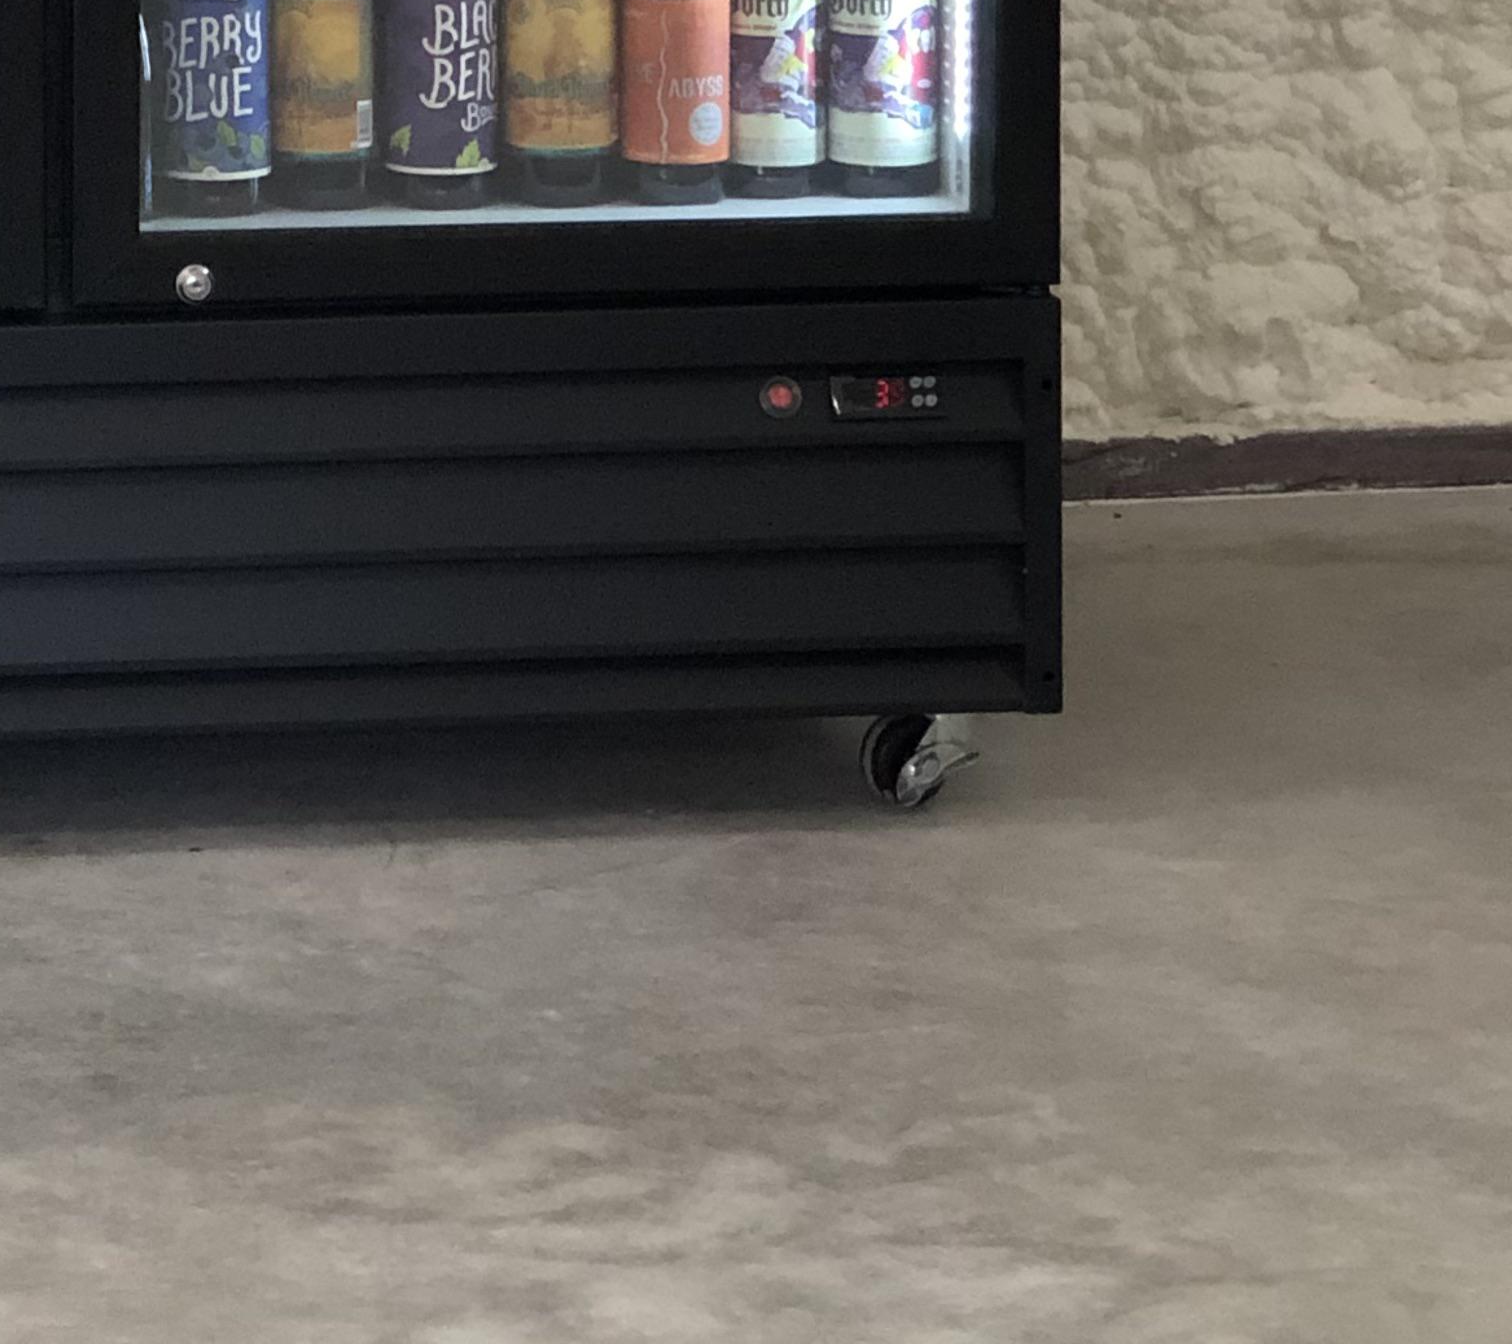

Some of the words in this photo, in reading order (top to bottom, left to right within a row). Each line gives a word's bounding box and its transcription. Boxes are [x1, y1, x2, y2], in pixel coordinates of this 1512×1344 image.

[162, 10, 263, 70] BERRY
[164, 66, 254, 123] BLUE
[668, 74, 724, 98] ABYSS
